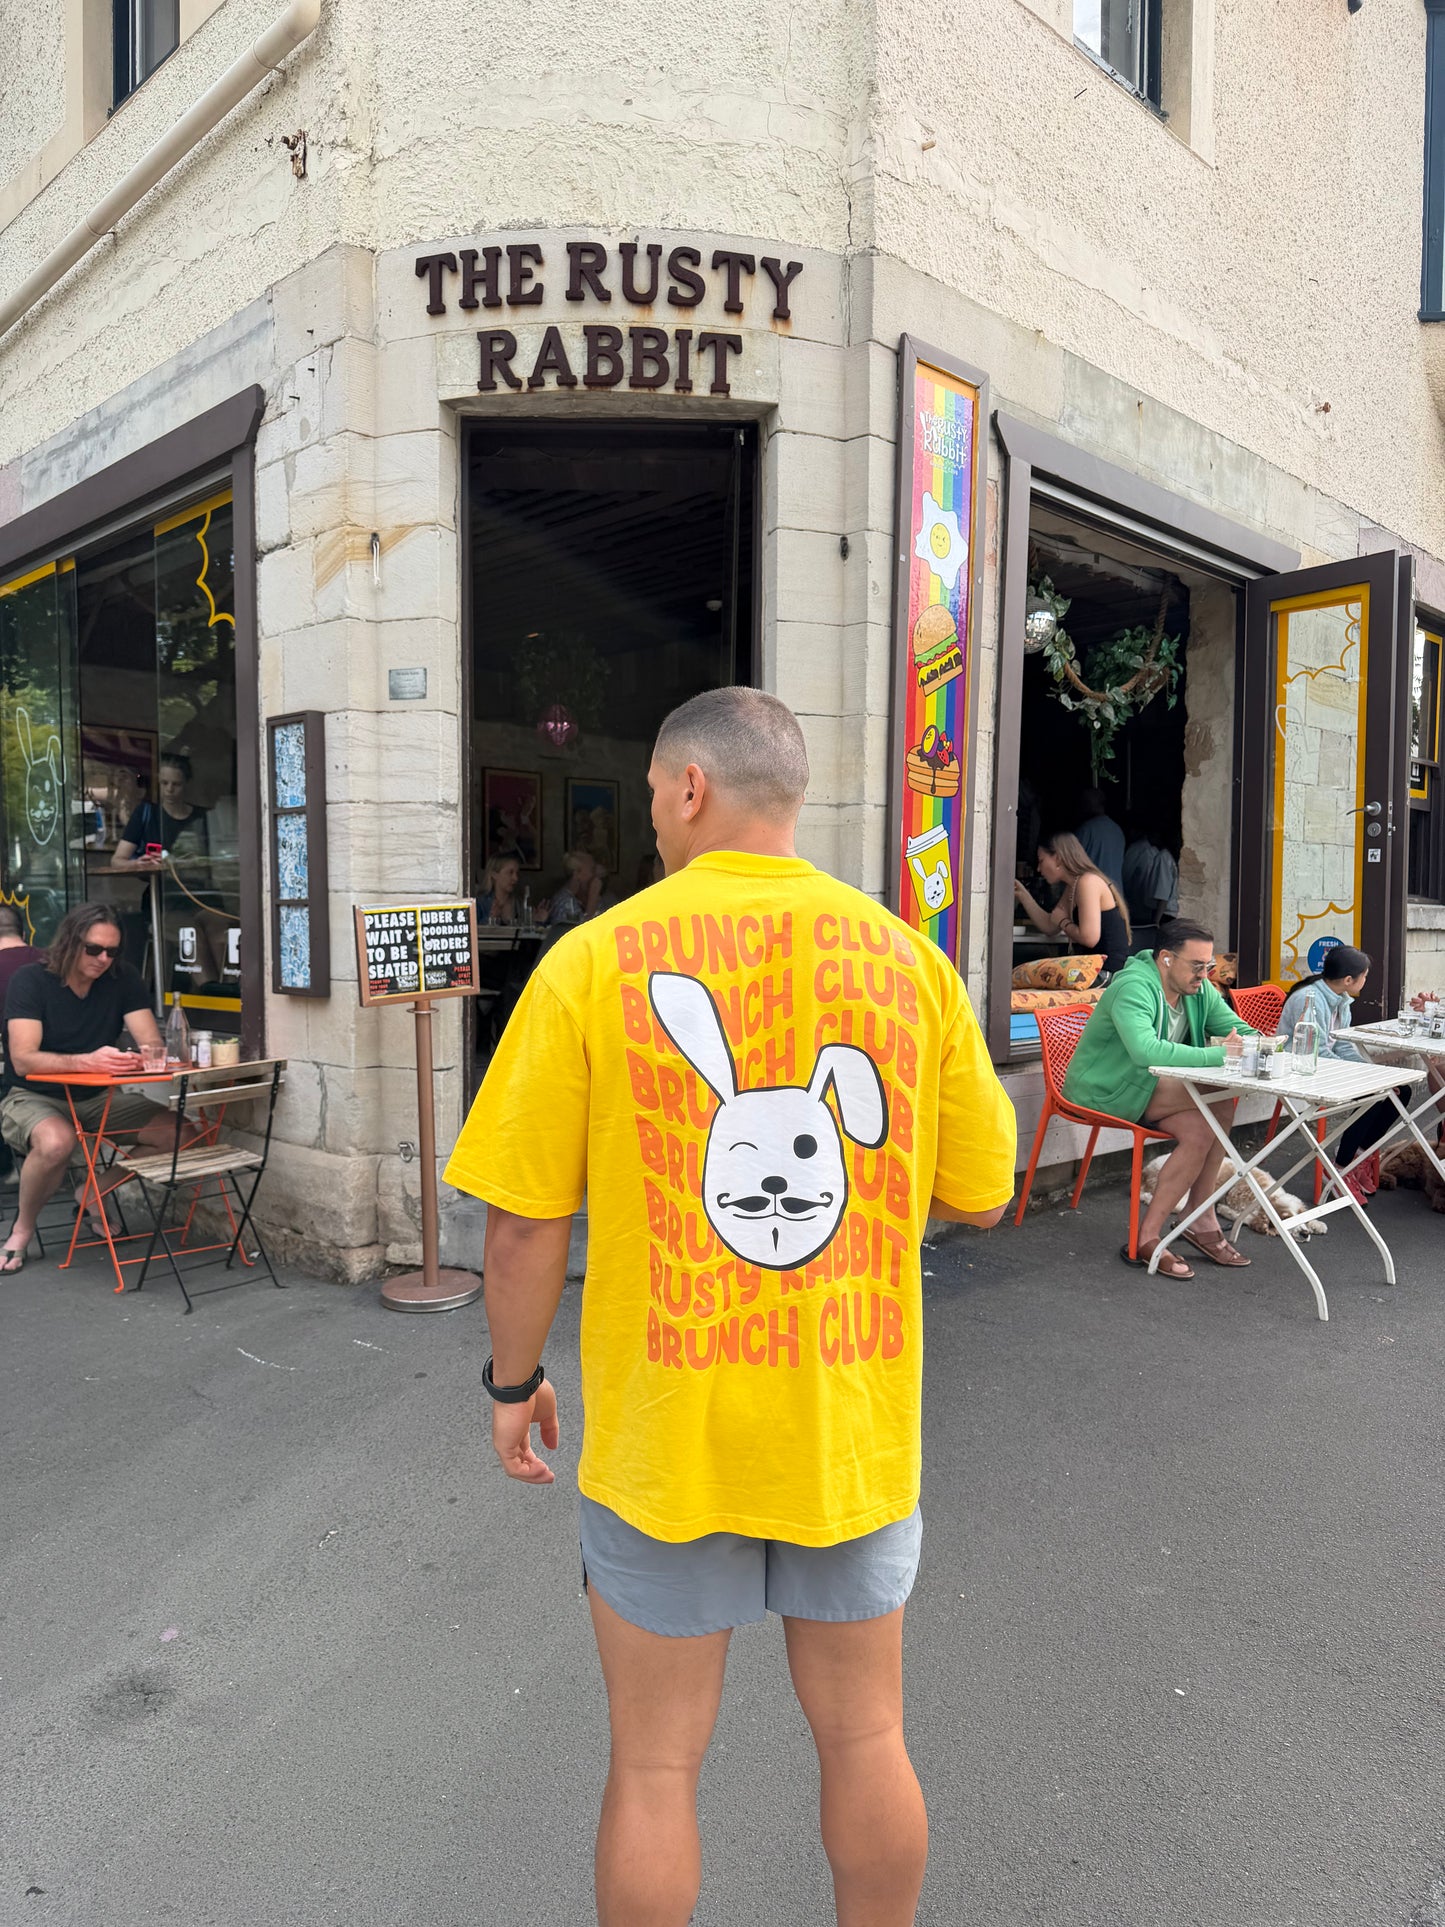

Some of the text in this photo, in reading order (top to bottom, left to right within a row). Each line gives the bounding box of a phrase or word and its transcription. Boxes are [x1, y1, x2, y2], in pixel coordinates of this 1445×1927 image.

[415, 242, 803, 319] THE RUSTY
[477, 325, 742, 394] RABBIT
[364, 912, 415, 930] PLEASE
[422, 910, 466, 925] UBER &
[365, 929, 402, 946] WAIT
[422, 924, 469, 937] DOORDASH
[614, 912, 916, 976] BRUNCH CLUB
[1318, 940, 1339, 948] FRESH
[367, 945, 408, 963] TO BE
[424, 951, 470, 967] PICK UP
[368, 961, 418, 979] SEATED
[814, 959, 919, 1026] CLUB
[650, 1241, 762, 1318] RUSTY
[647, 1290, 905, 1371] BRUNCH CLUB
